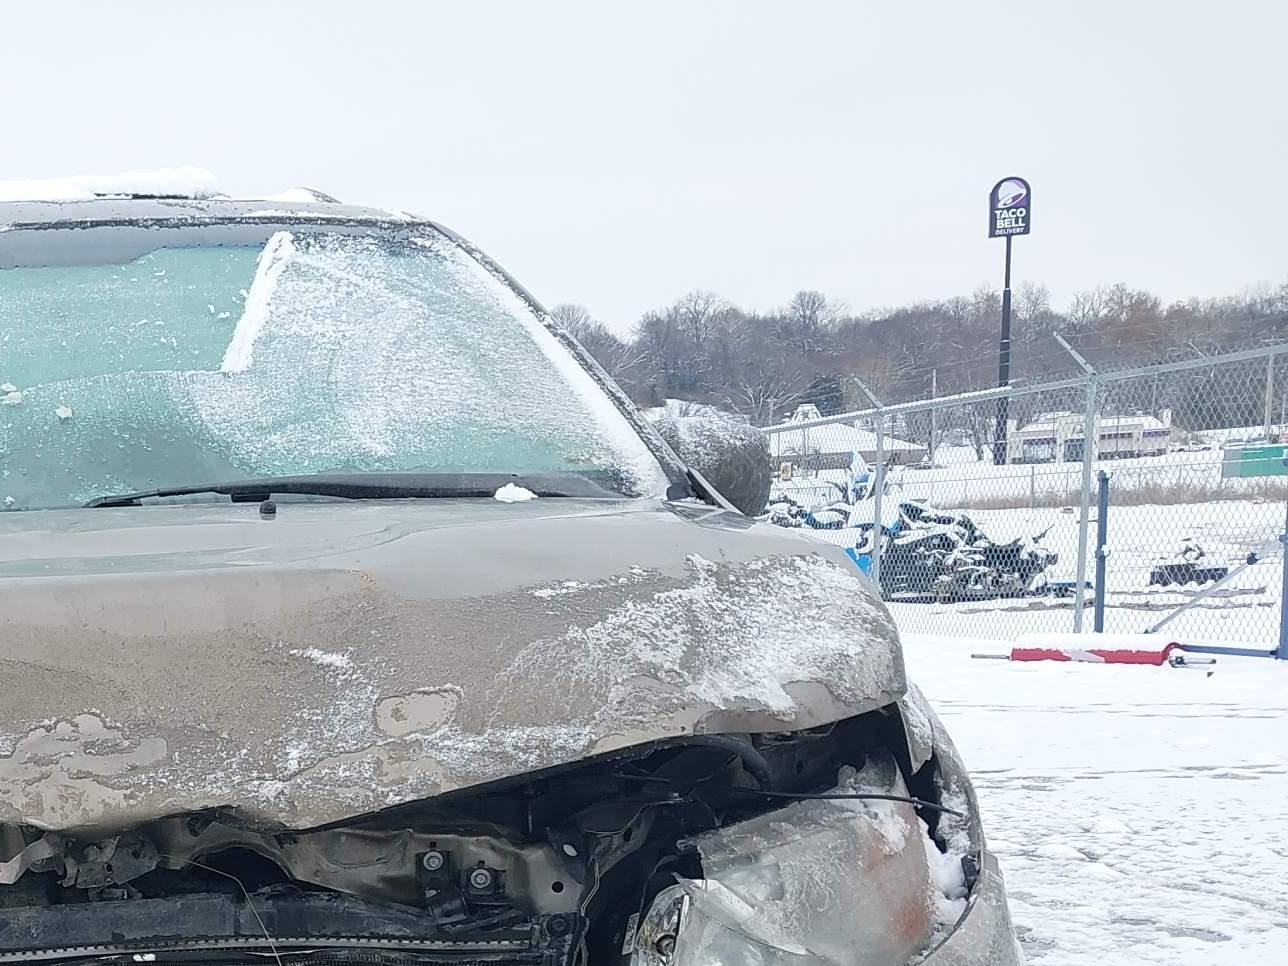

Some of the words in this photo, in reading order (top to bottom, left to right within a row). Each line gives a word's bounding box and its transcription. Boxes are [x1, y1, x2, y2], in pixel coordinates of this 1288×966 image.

[994, 208, 1027, 220] TACO
[996, 218, 1026, 229] BELL
[995, 227, 1025, 235] DELIVERY
